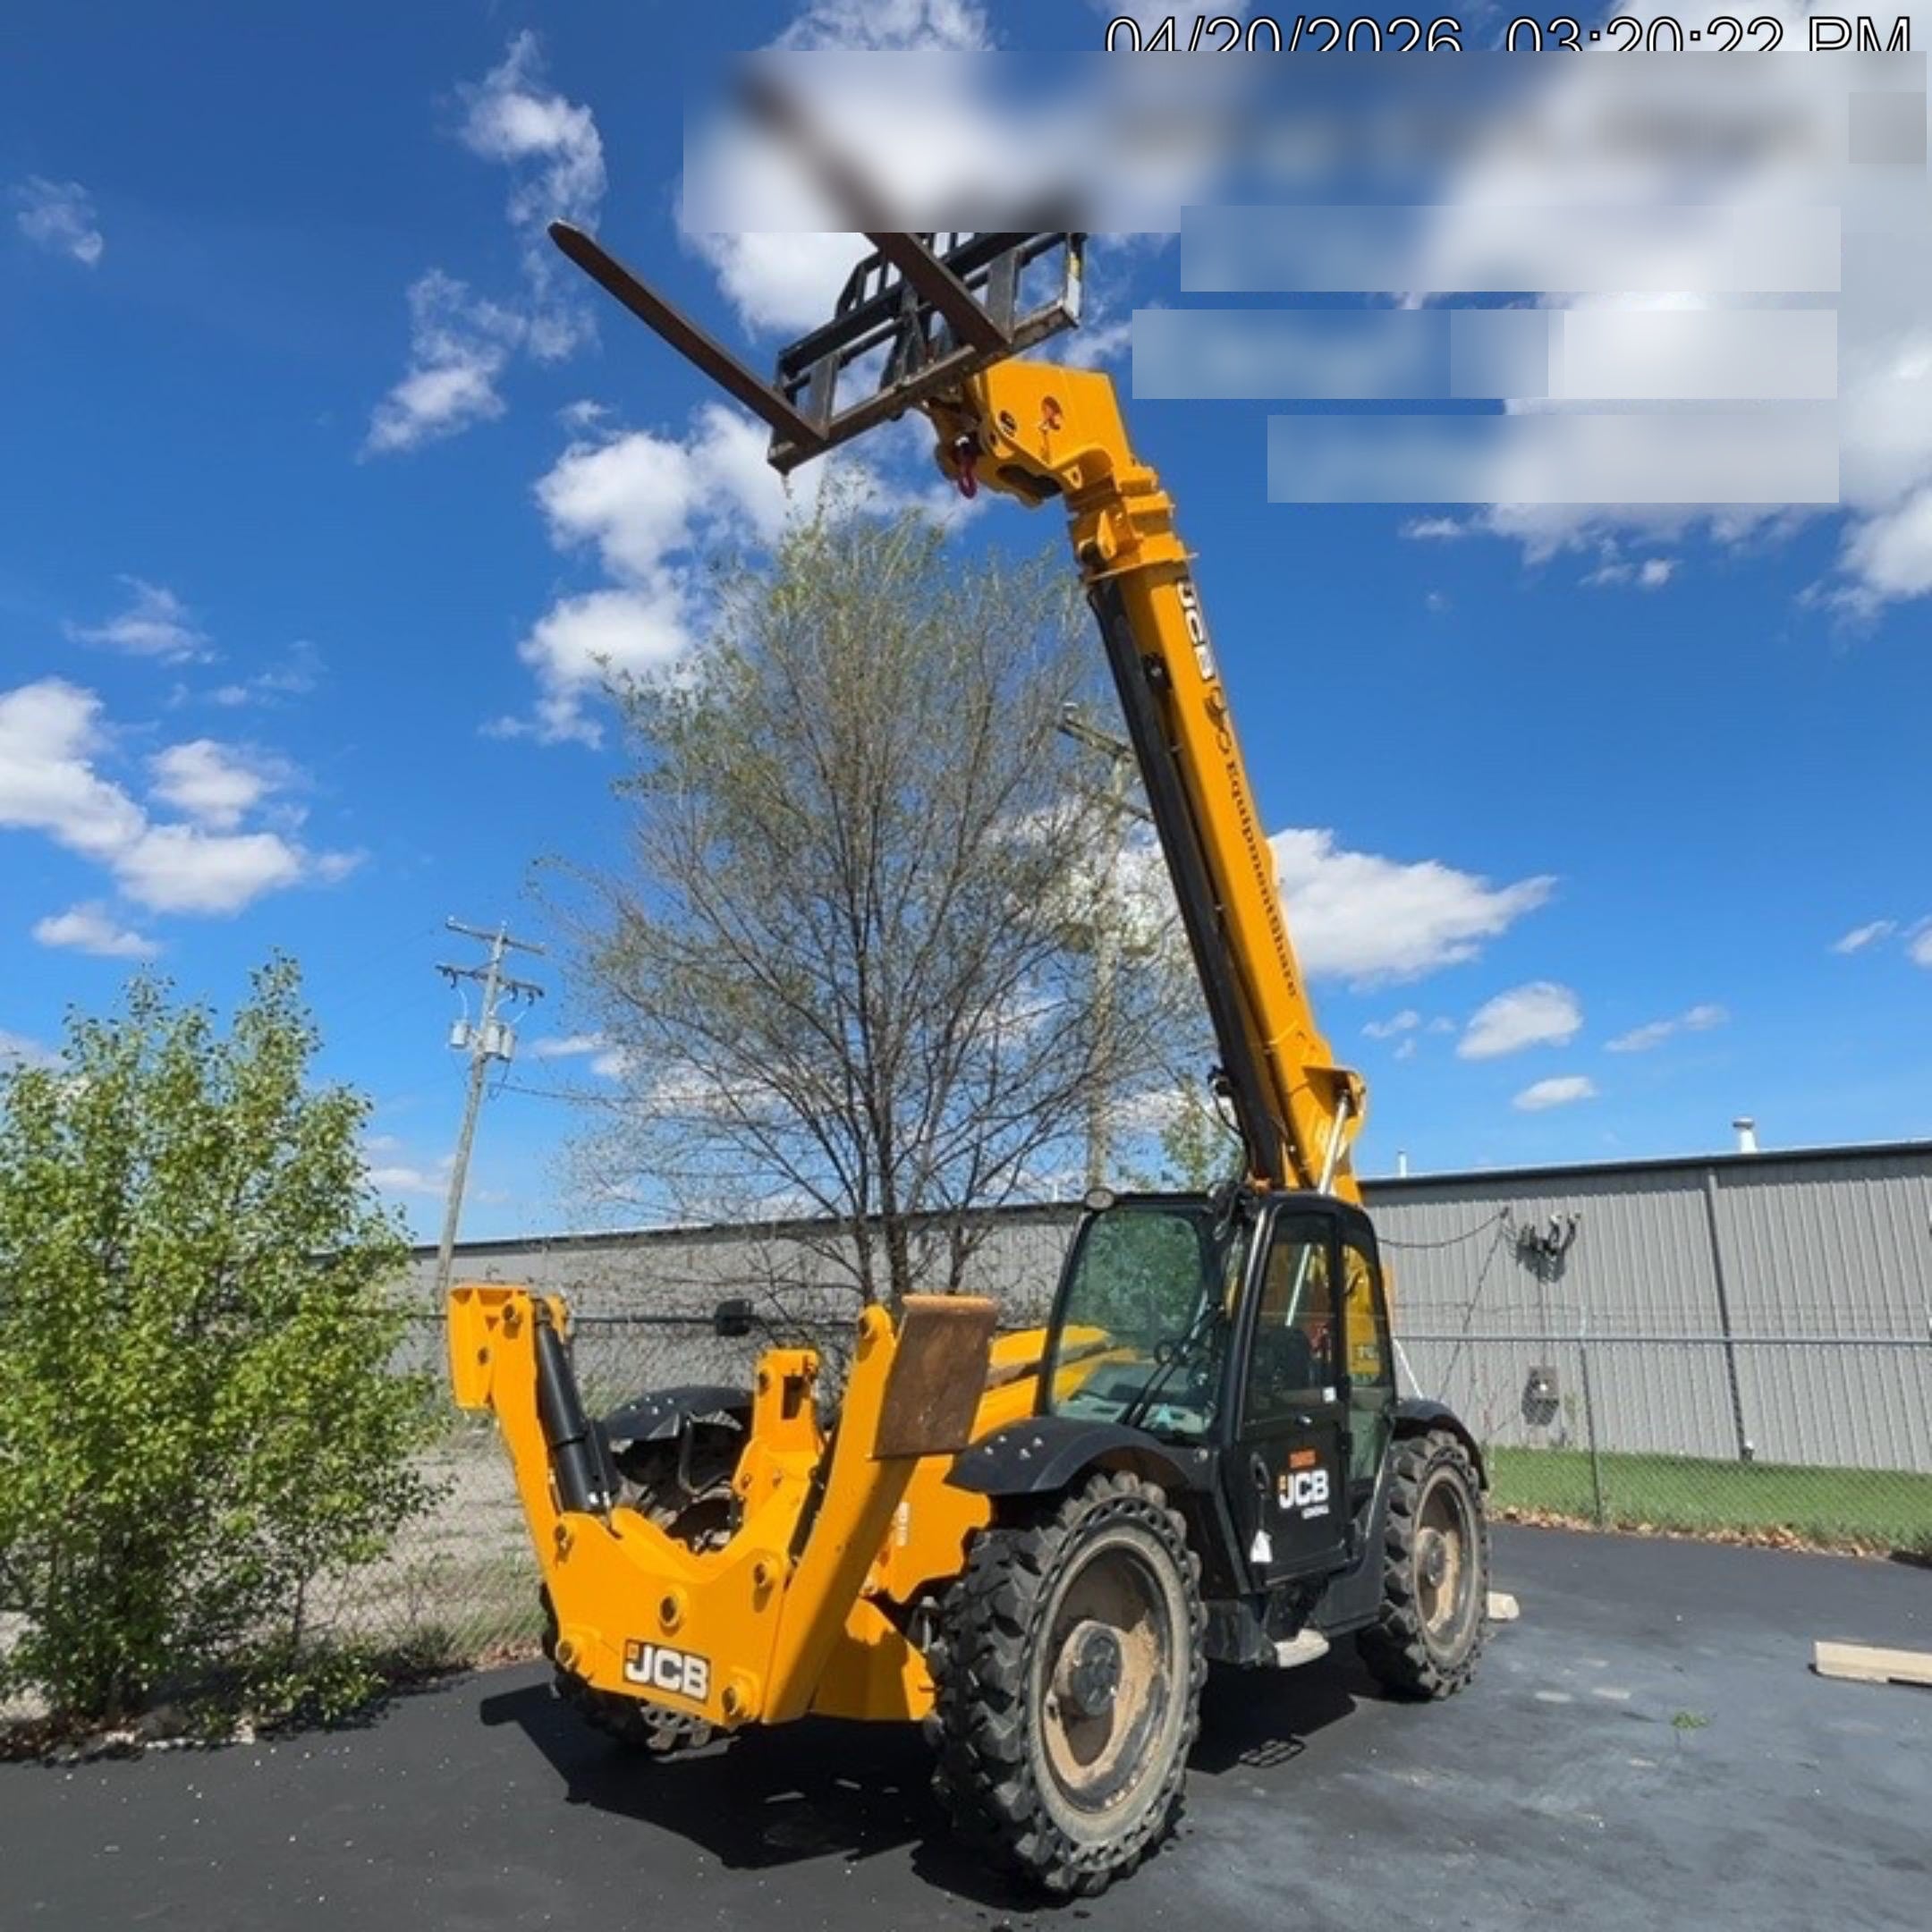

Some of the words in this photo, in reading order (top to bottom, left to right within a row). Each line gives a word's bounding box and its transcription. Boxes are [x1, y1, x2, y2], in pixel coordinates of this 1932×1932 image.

[1176, 580, 1216, 682] JCB
[1278, 1469, 1329, 1509] JCB
[624, 1642, 708, 1700] JCB
